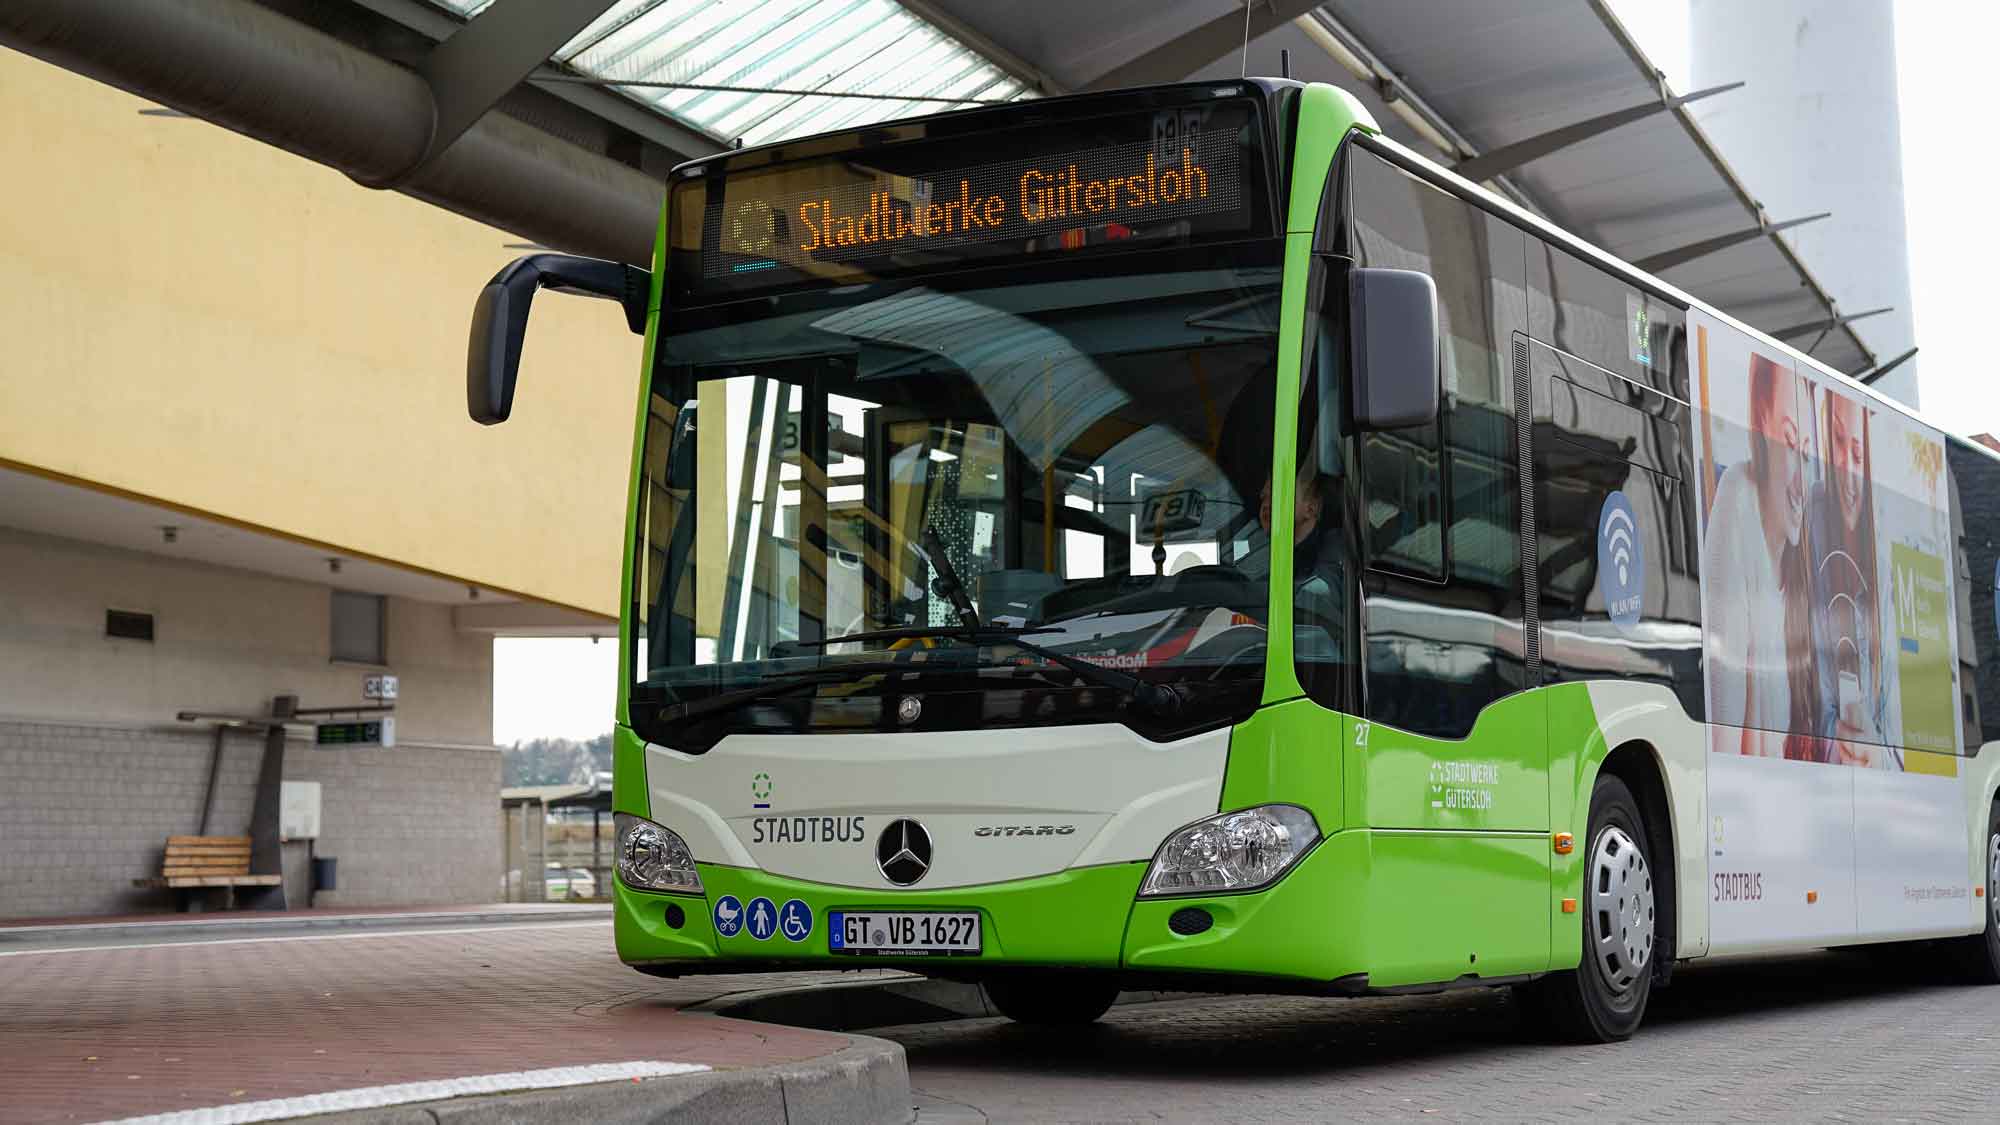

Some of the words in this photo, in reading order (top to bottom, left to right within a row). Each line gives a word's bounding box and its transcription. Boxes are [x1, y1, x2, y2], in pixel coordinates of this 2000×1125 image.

[799, 179, 1005, 252] Stadtwerke
[1019, 146, 1209, 222] Gütersloh
[1444, 761, 1499, 785] STADTWERKE
[1445, 788, 1492, 809] GÜTERSLOH
[753, 816, 865, 844] STADTBUS
[974, 824, 1076, 838] CITARO
[1713, 872, 1762, 902] STADTBUS
[844, 916, 872, 945] GT
[888, 916, 916, 945] VB
[919, 916, 975, 945] 1627
